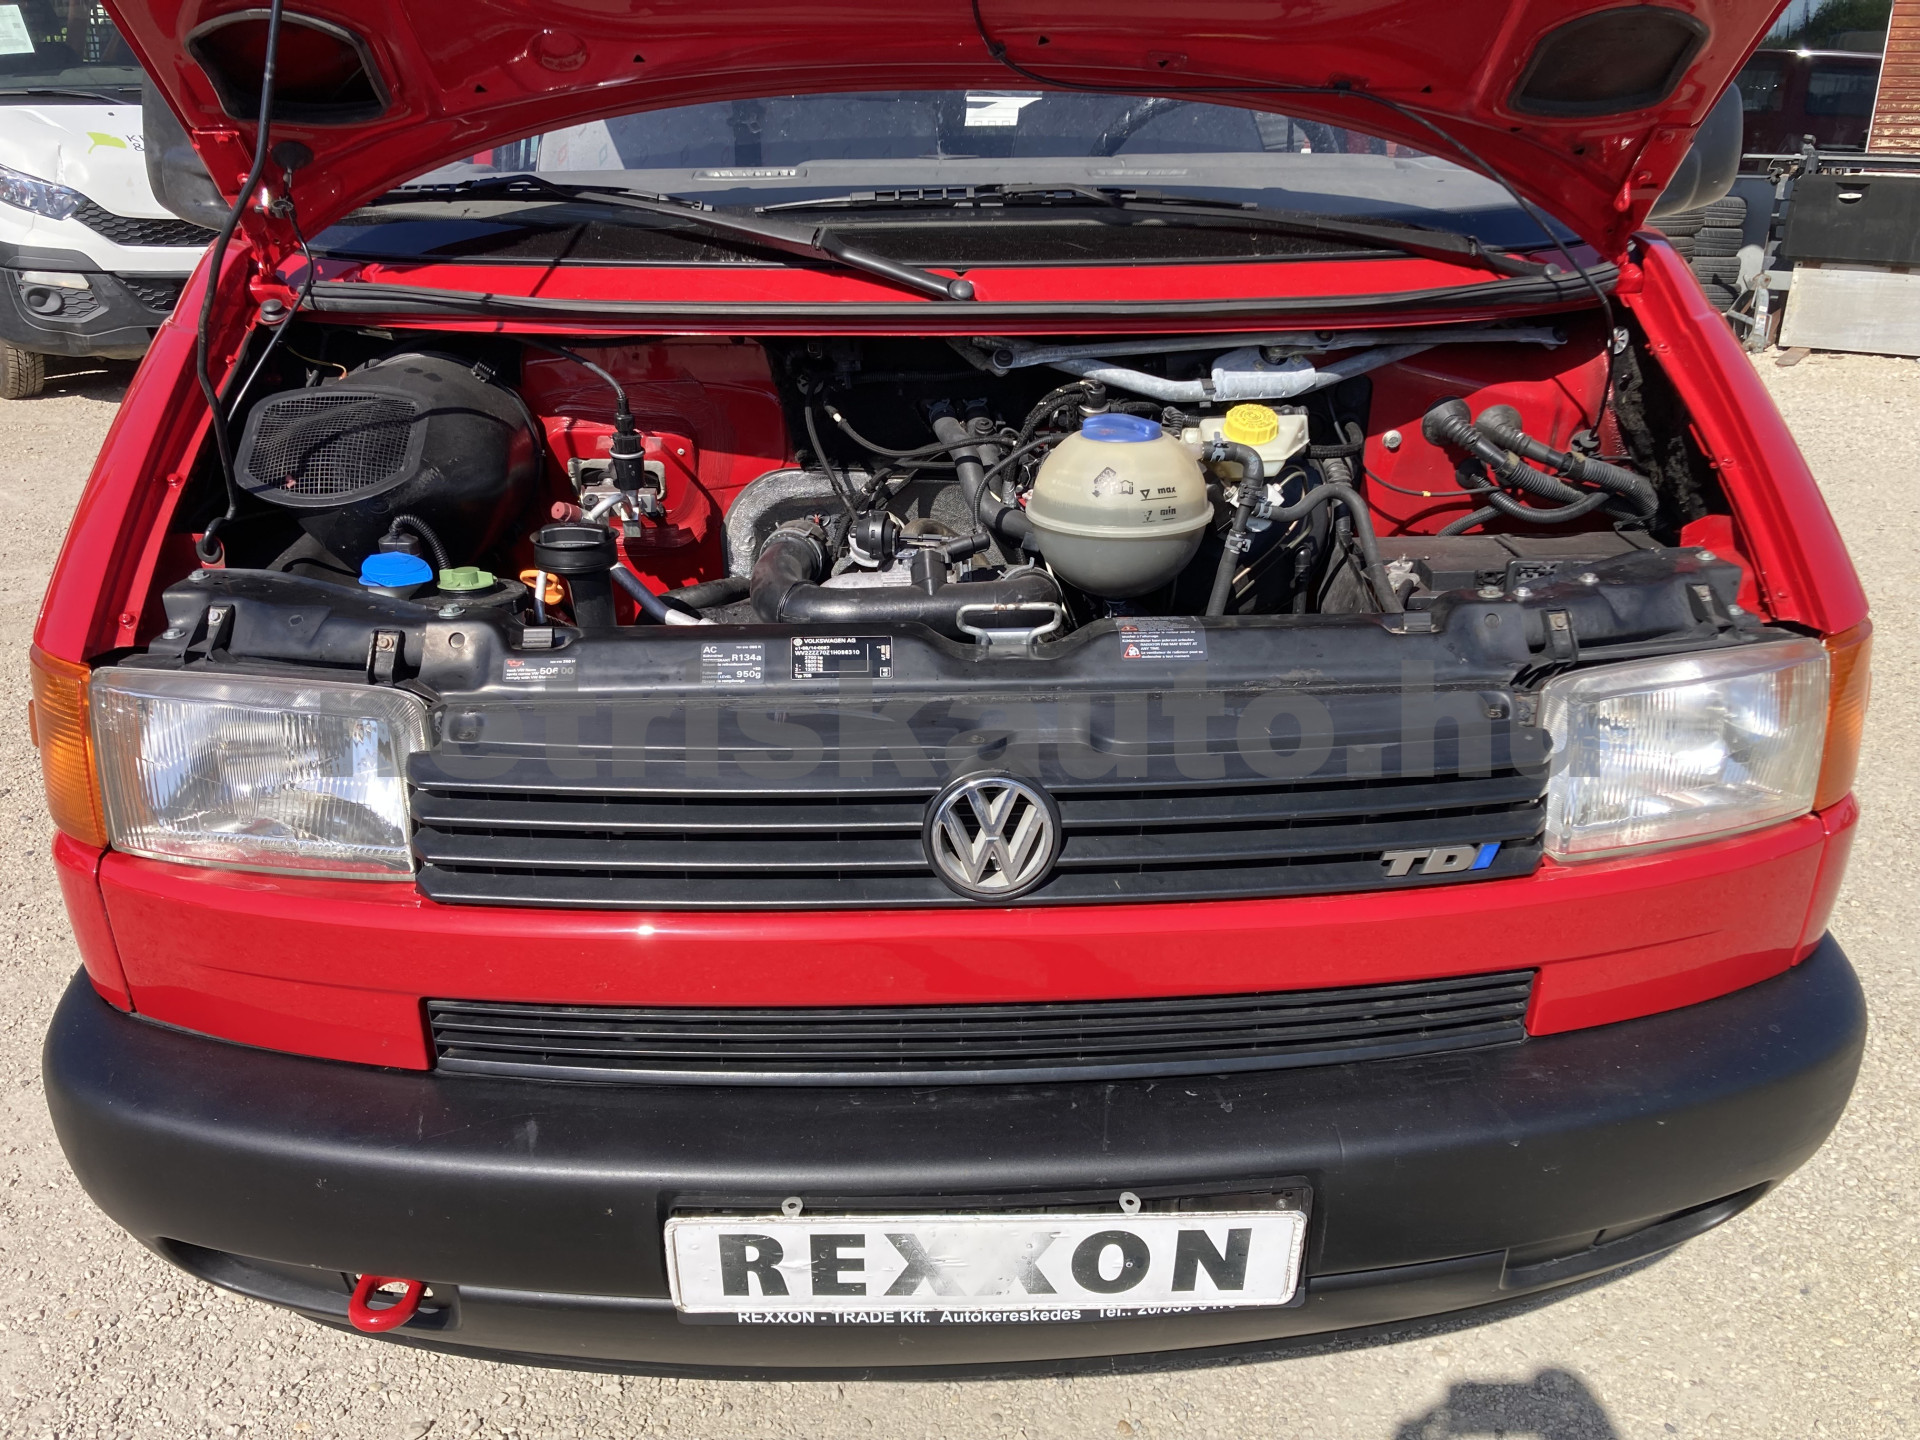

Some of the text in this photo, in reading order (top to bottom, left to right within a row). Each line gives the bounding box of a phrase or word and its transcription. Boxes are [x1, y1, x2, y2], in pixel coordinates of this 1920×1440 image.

[1157, 486, 1176, 495] max
[1160, 506, 1176, 516] min
[703, 646, 718, 654] AC
[736, 670, 761, 679] 950g
[1380, 842, 1501, 877] TDI
[718, 1227, 1252, 1297] REXXON
[738, 1312, 815, 1324] REXXON
[832, 1311, 895, 1324] TRADE
[900, 1310, 930, 1324] Kft.
